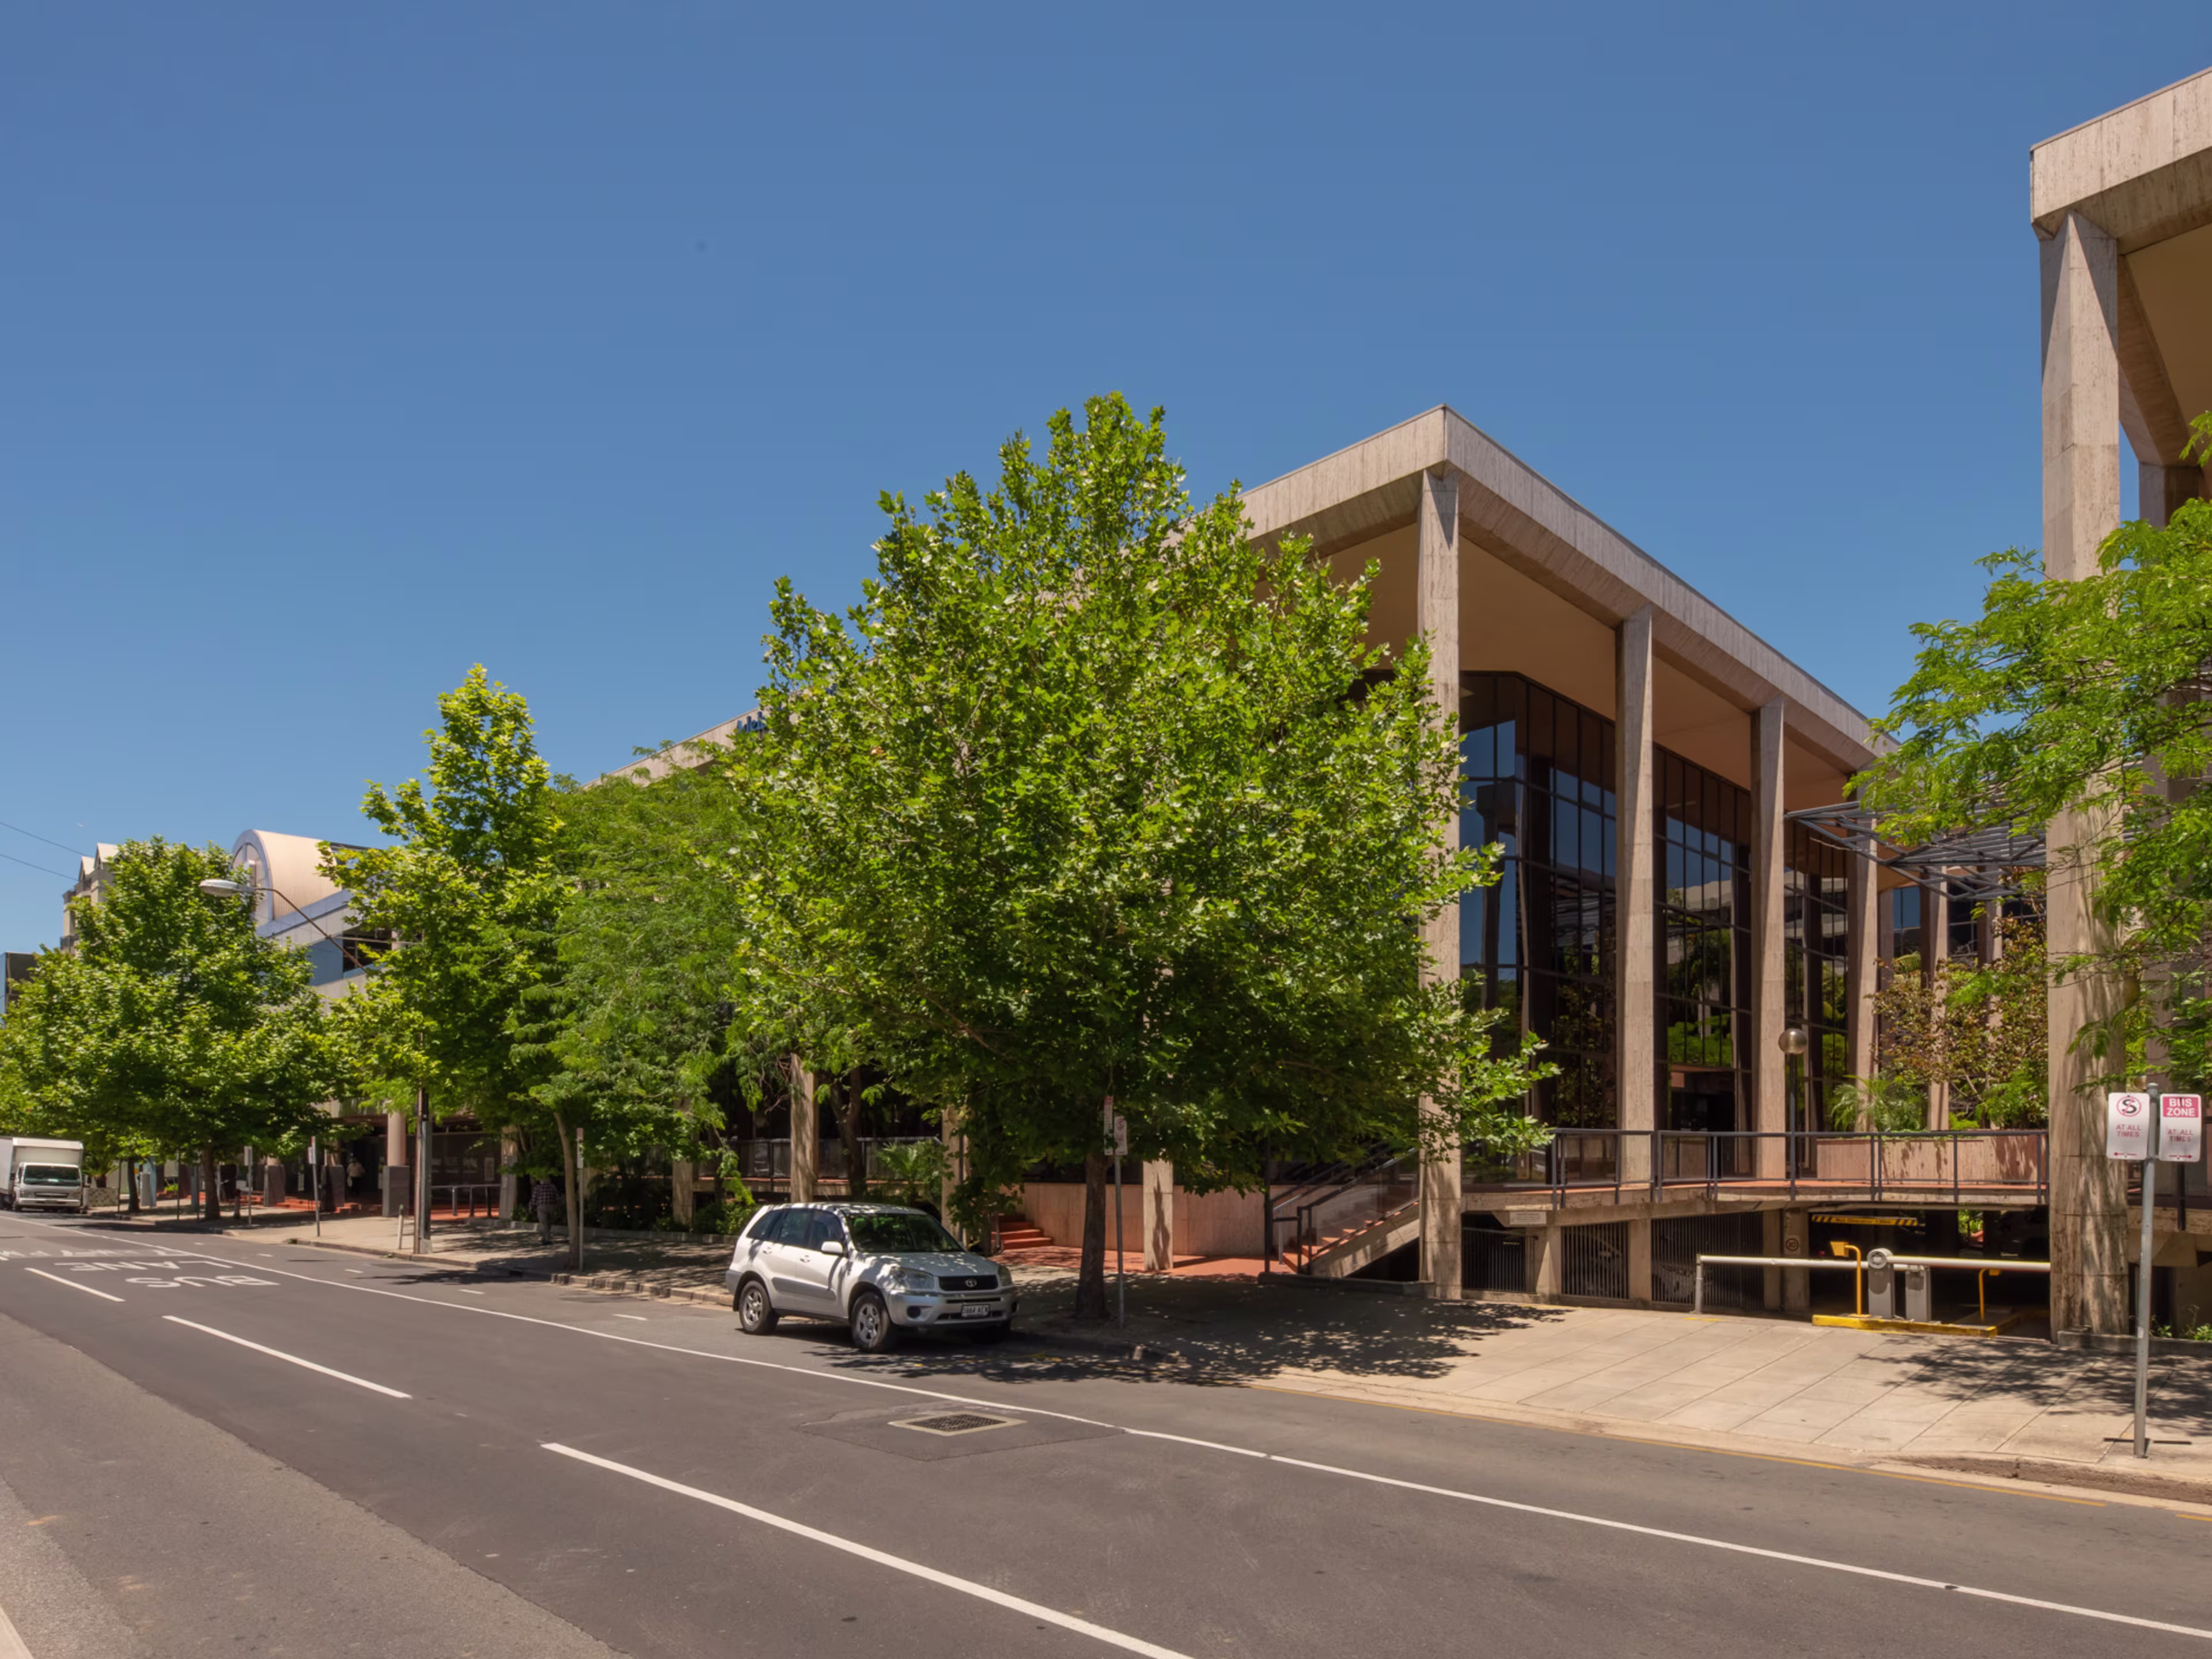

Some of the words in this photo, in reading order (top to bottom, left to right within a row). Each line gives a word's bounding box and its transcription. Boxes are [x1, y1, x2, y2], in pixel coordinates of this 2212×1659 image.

[2169, 1097, 2192, 1107] BUS
[2166, 1107, 2195, 1117] ZONE
[54, 1260, 233, 1271] LANE
[124, 1275, 281, 1288] BUS
